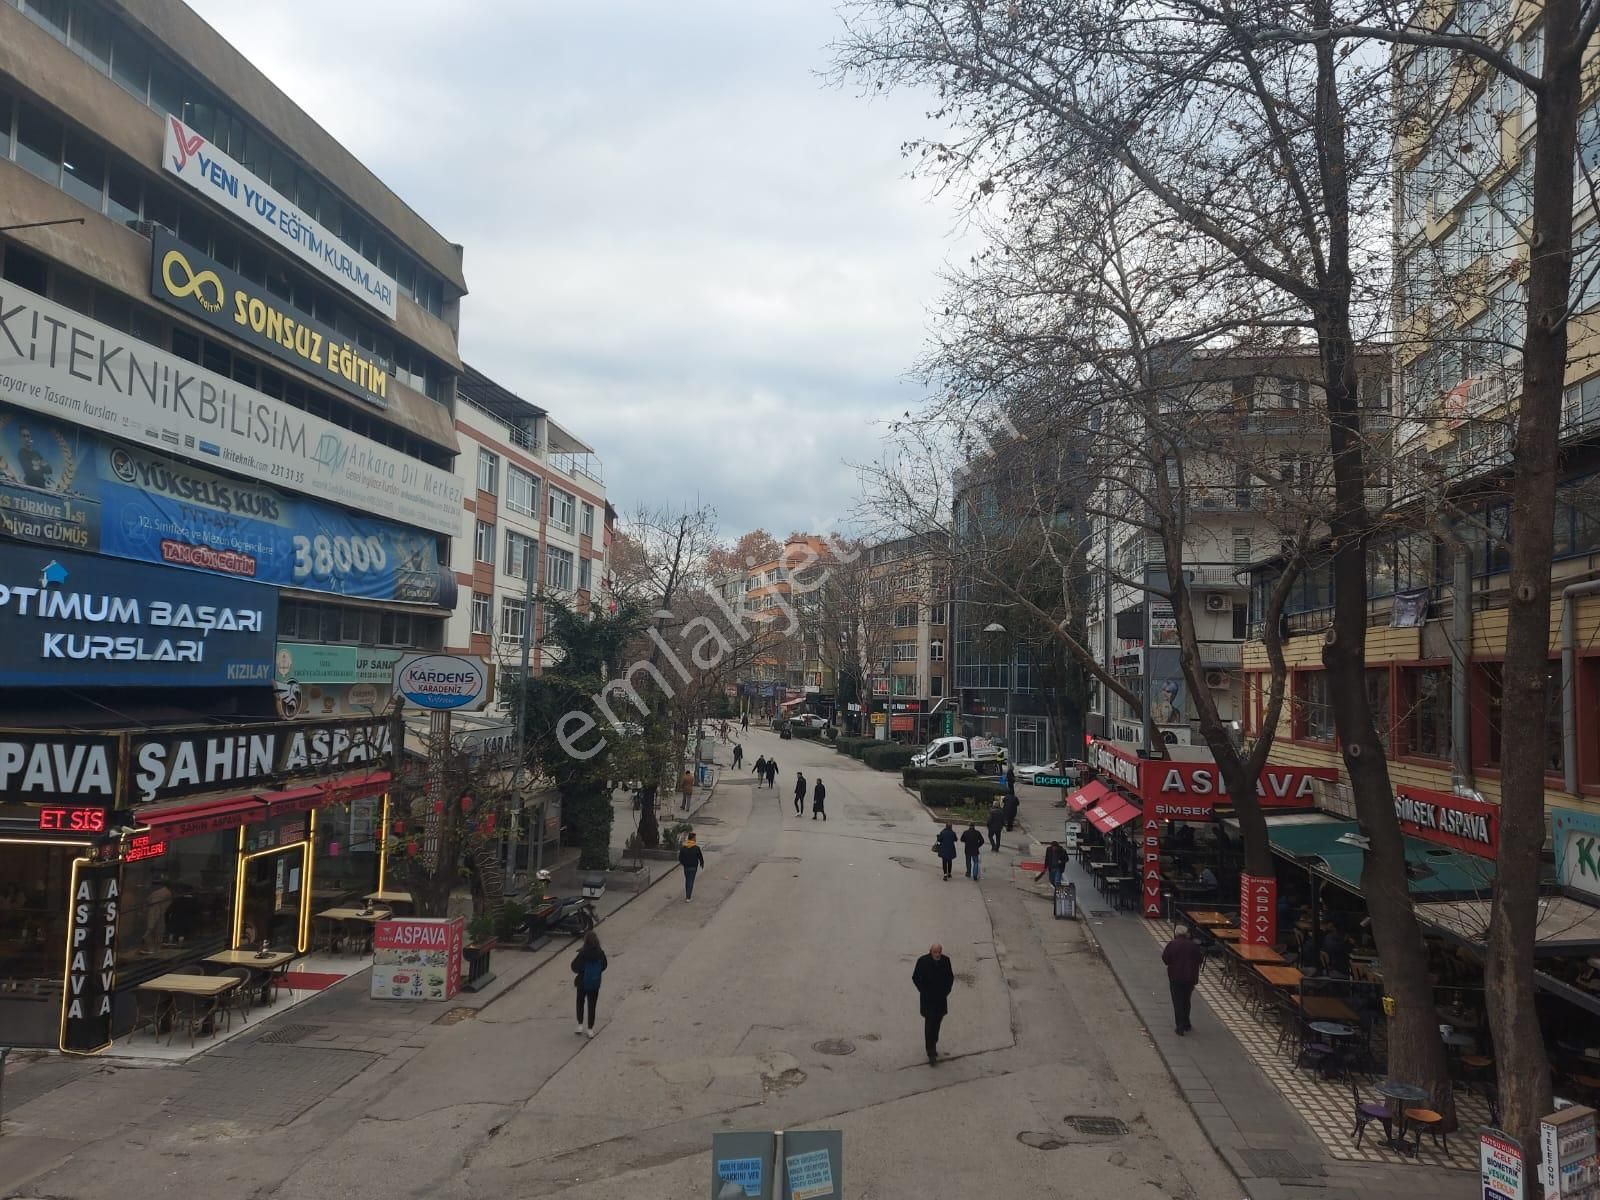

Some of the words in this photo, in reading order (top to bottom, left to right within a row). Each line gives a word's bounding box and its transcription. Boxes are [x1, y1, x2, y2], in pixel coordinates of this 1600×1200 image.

[198, 151, 238, 199] YENİ
[244, 184, 276, 225] YÜZ
[280, 211, 322, 259] EĞİTİM
[325, 243, 391, 306] KURUMLARI
[234, 290, 322, 365] SONSUZ
[328, 343, 386, 398] EĞİTİM
[30, 386, 41, 398] ve
[44, 386, 81, 410] Tasarım
[83, 399, 118, 422] kursları
[350, 444, 395, 479] Ankara
[401, 463, 418, 488] Dil
[424, 473, 463, 502] Merkezi
[15, 496, 61, 518] TÜRKİYE
[136, 462, 232, 513] YÜKSELİŞ
[233, 489, 279, 521] KURS
[44, 522, 88, 547] GÜMÜŞ
[293, 535, 386, 577] 38000
[150, 601, 262, 637] BAŞARI
[42, 632, 204, 663] KURSLARI
[227, 663, 270, 680] KIZILAY
[409, 670, 474, 683] KARDENS
[418, 683, 462, 694] KARADENİZ
[136, 734, 275, 802] ŞAHİN
[1161, 769, 1314, 799] ASAVA
[41, 810, 66, 829] ET
[1155, 803, 1212, 816] ŞİMŞEK
[1439, 807, 1490, 845] ASPAVA
[1145, 819, 1160, 914] ASPAVA
[1255, 886, 1269, 943] ASPAVA
[68, 881, 91, 1019] ASPAVA
[100, 880, 119, 1016] ASPAVA
[394, 926, 446, 945] ASPAVA
